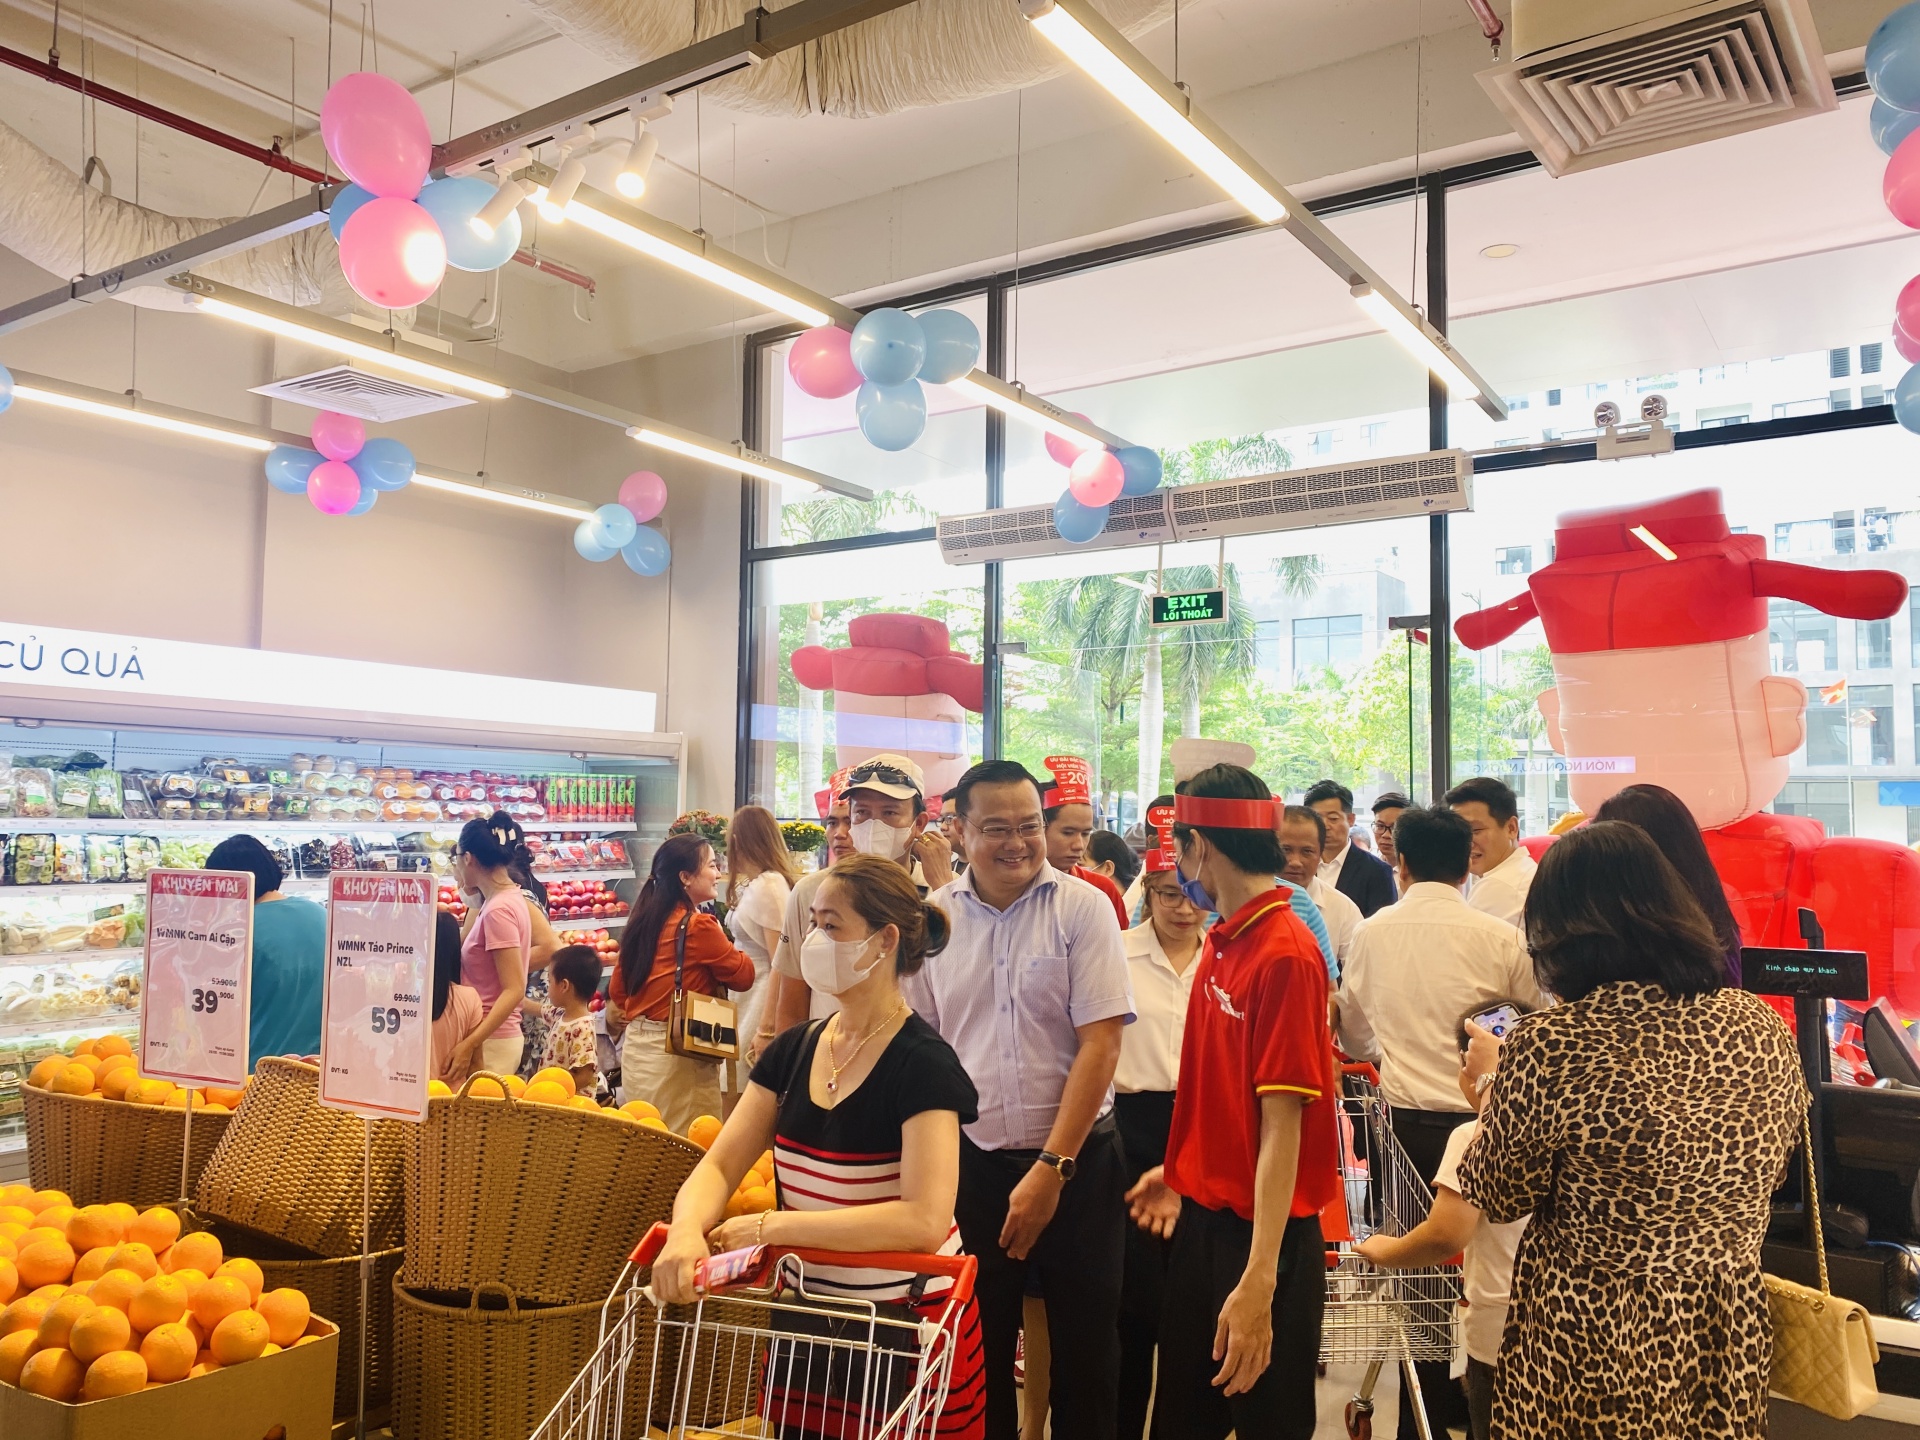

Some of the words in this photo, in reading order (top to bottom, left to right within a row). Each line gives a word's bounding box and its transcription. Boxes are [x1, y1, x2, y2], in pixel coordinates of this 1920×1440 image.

[1168, 595, 1207, 609] EXIT
[1163, 608, 1179, 620] LỖI
[1181, 607, 1213, 619] THOÁT
[61, 646, 145, 680] QUẢ
[1163, 817, 1174, 825] HỘ
[162, 875, 212, 892] KHUYẾN
[215, 878, 239, 896] MẠI
[156, 928, 186, 940] WMNK
[188, 931, 207, 941] Cam
[209, 932, 218, 942] Ai
[220, 934, 236, 946] Cập
[337, 940, 366, 951] WMNK
[368, 941, 384, 953] Táo
[386, 942, 414, 954] Prince
[336, 956, 353, 967] NZL
[1818, 966, 1838, 974] khach
[191, 988, 218, 1014] 39
[371, 1006, 401, 1034] 59
